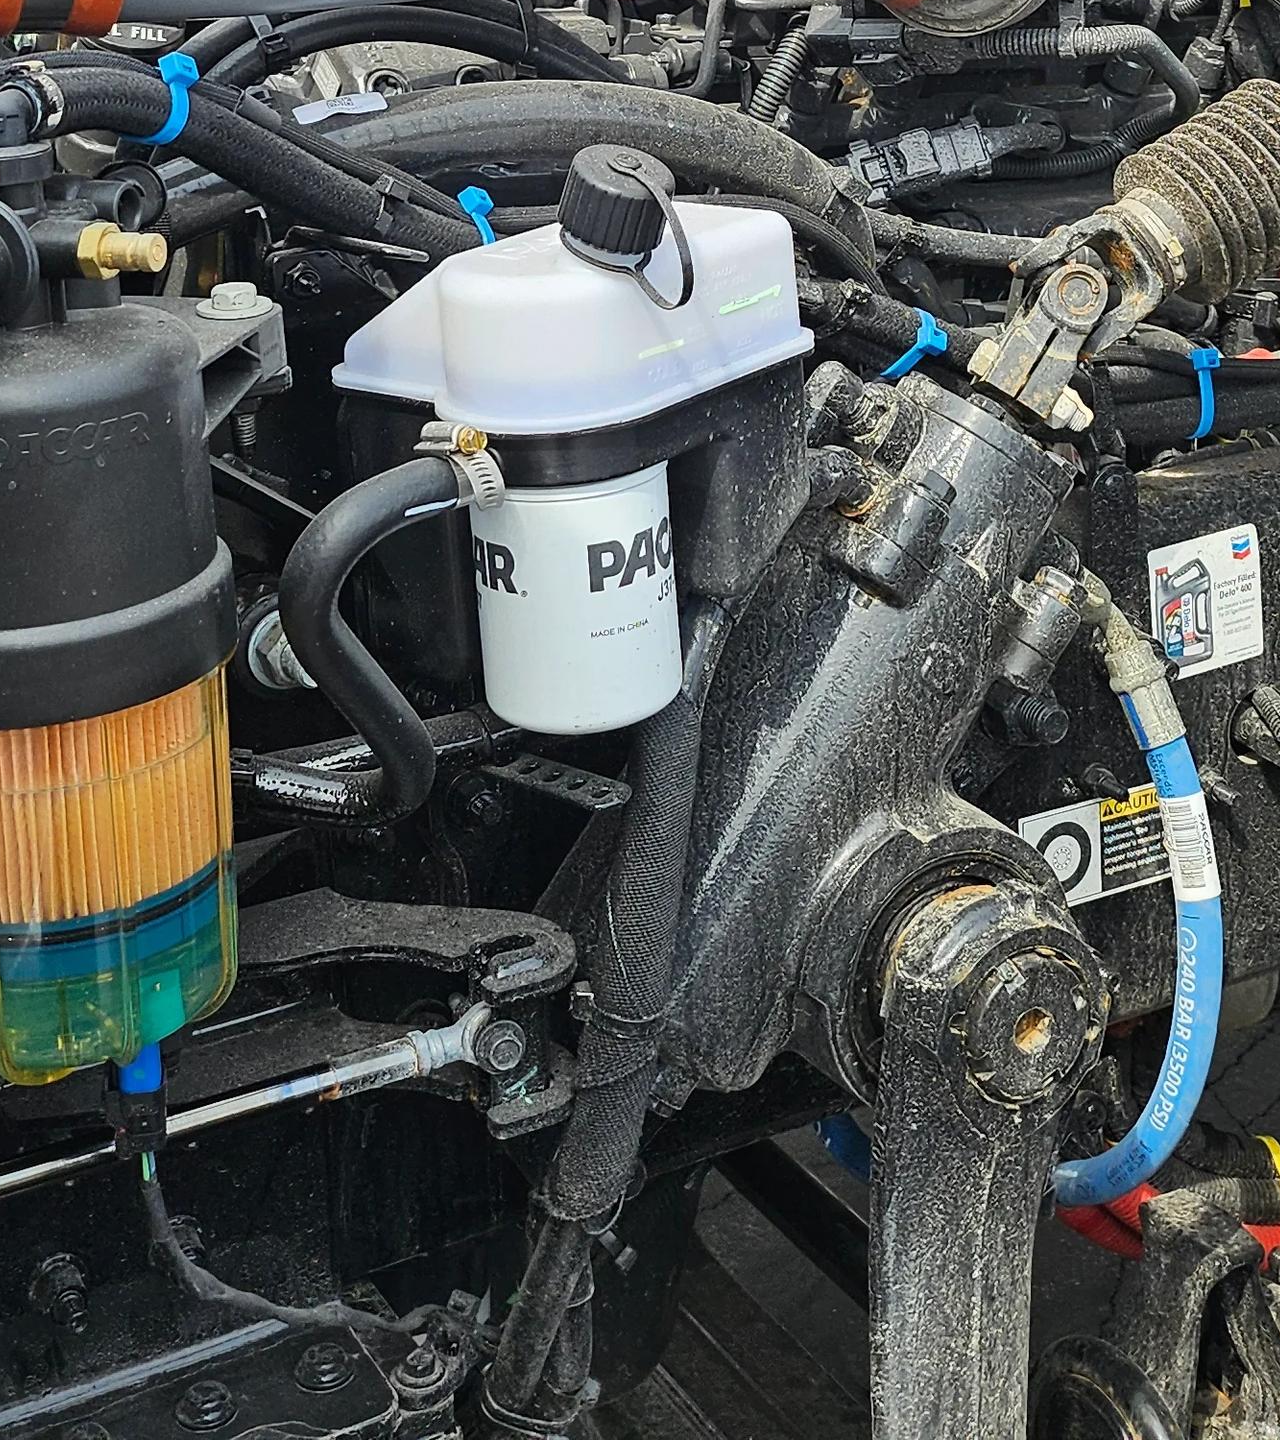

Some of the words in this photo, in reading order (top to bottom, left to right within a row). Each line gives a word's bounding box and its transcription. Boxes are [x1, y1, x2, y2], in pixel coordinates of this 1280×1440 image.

[130, 26, 167, 42] FILL
[587, 516, 671, 593] PAC
[1214, 579, 1236, 591] Factory
[590, 629, 616, 639] MADE
[1180, 953, 1196, 992] 240
[1176, 993, 1195, 1042] BAR
[1163, 1042, 1189, 1097] (3500
[1149, 1095, 1175, 1132] PSI)
